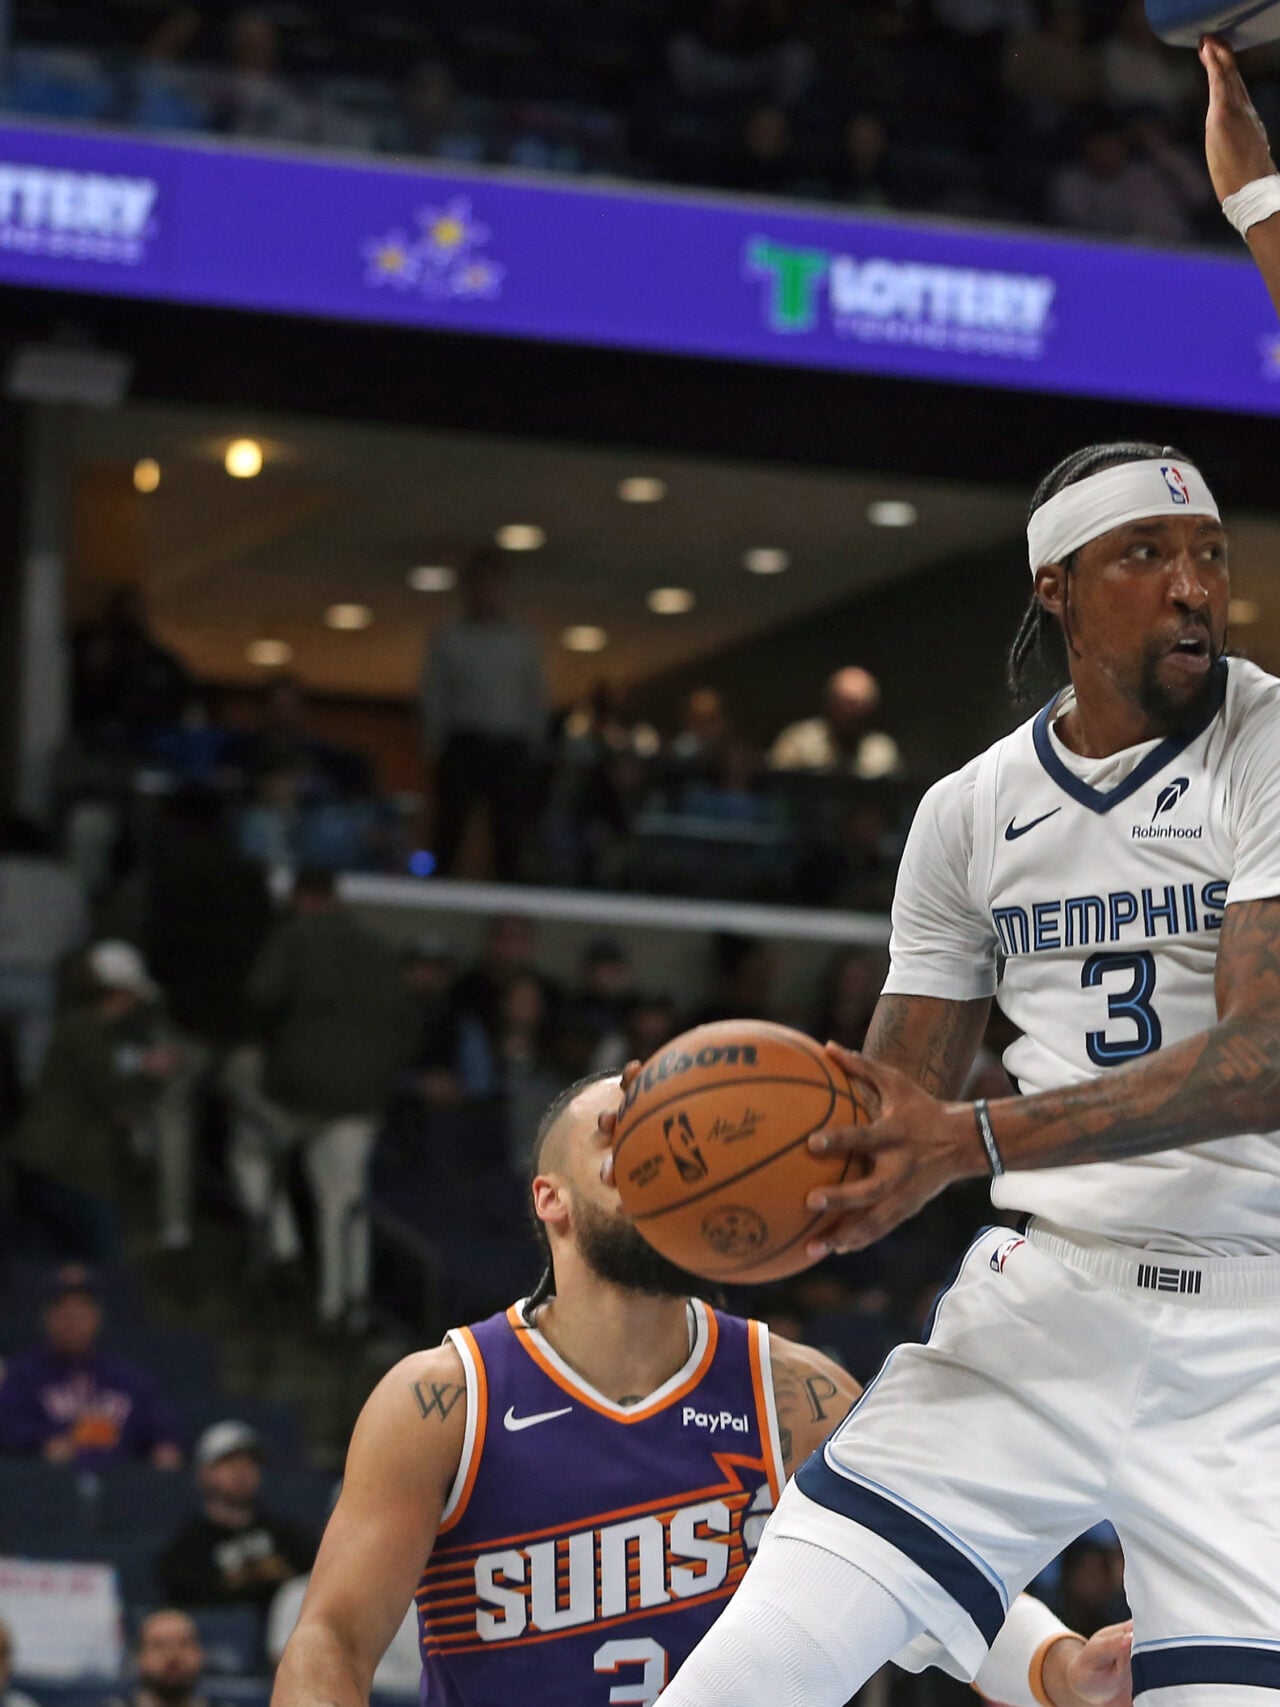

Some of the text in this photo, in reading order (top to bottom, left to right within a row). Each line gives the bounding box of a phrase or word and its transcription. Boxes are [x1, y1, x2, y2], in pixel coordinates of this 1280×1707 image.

[1131, 825, 1202, 840] Robinhood
[992, 879, 1230, 956] MEMPHIS
[1081, 950, 1162, 1067] 3
[682, 1406, 749, 1434] PayPal
[474, 1500, 731, 1642] SUNS
